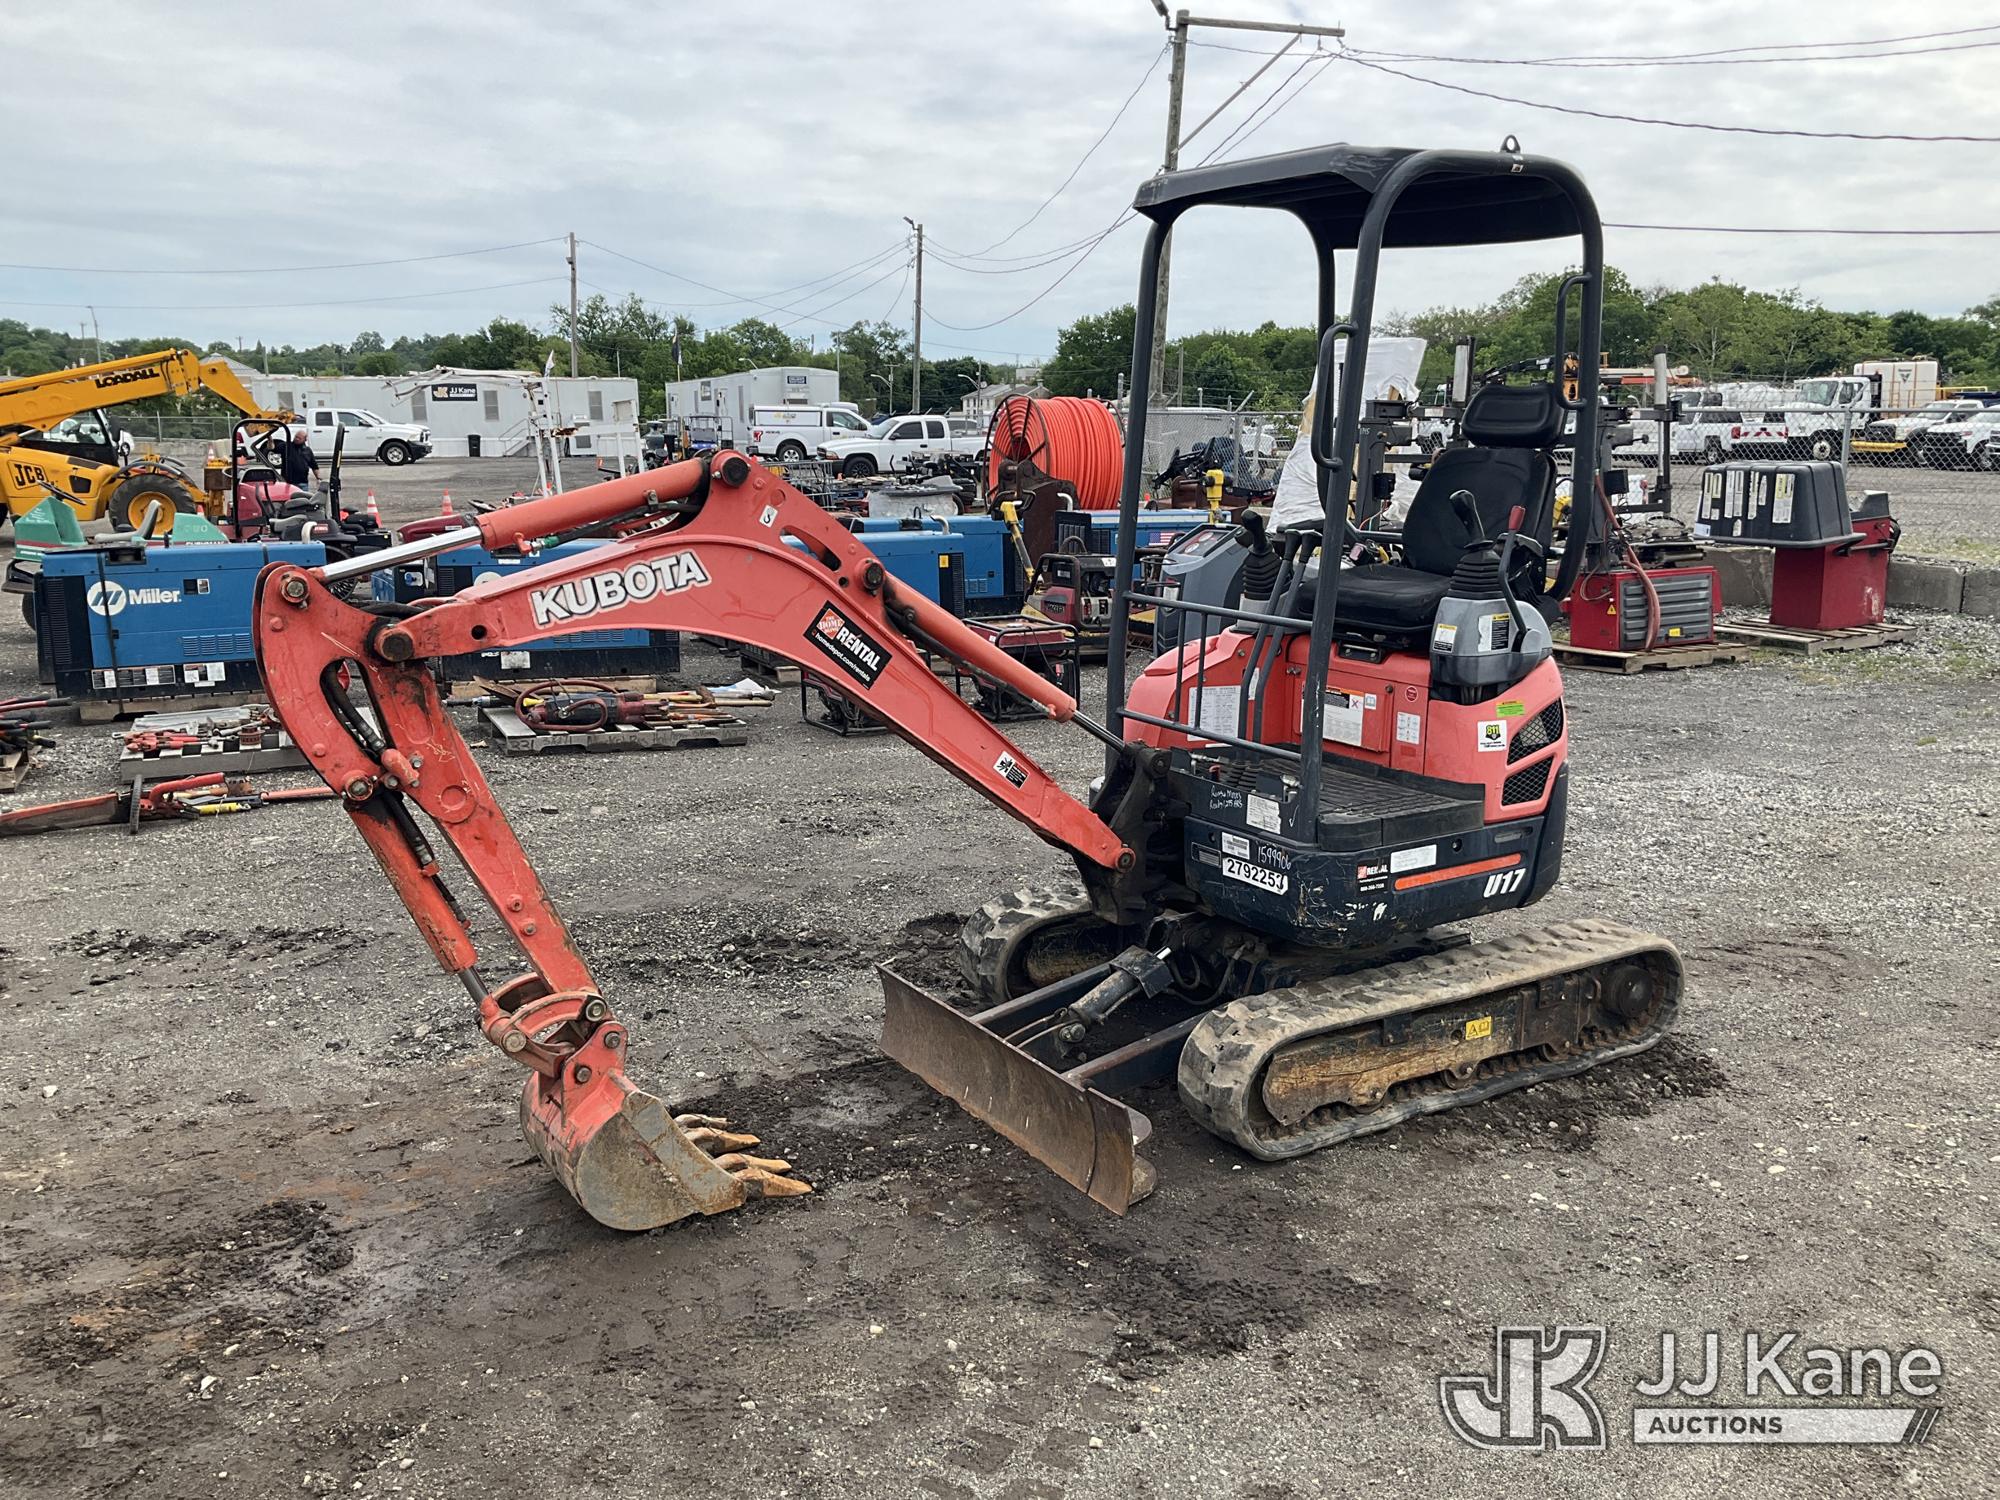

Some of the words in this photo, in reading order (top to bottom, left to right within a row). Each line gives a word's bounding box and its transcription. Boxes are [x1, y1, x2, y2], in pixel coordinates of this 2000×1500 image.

[94, 368, 160, 389] LOADALL
[14, 463, 46, 487] JCB
[530, 551, 710, 626] KUBOTA
[815, 632, 871, 682] homedepot.com/rentals
[836, 627, 881, 672] RENTAL
[1486, 725, 1500, 735] 811
[1483, 868, 1527, 898] U17
